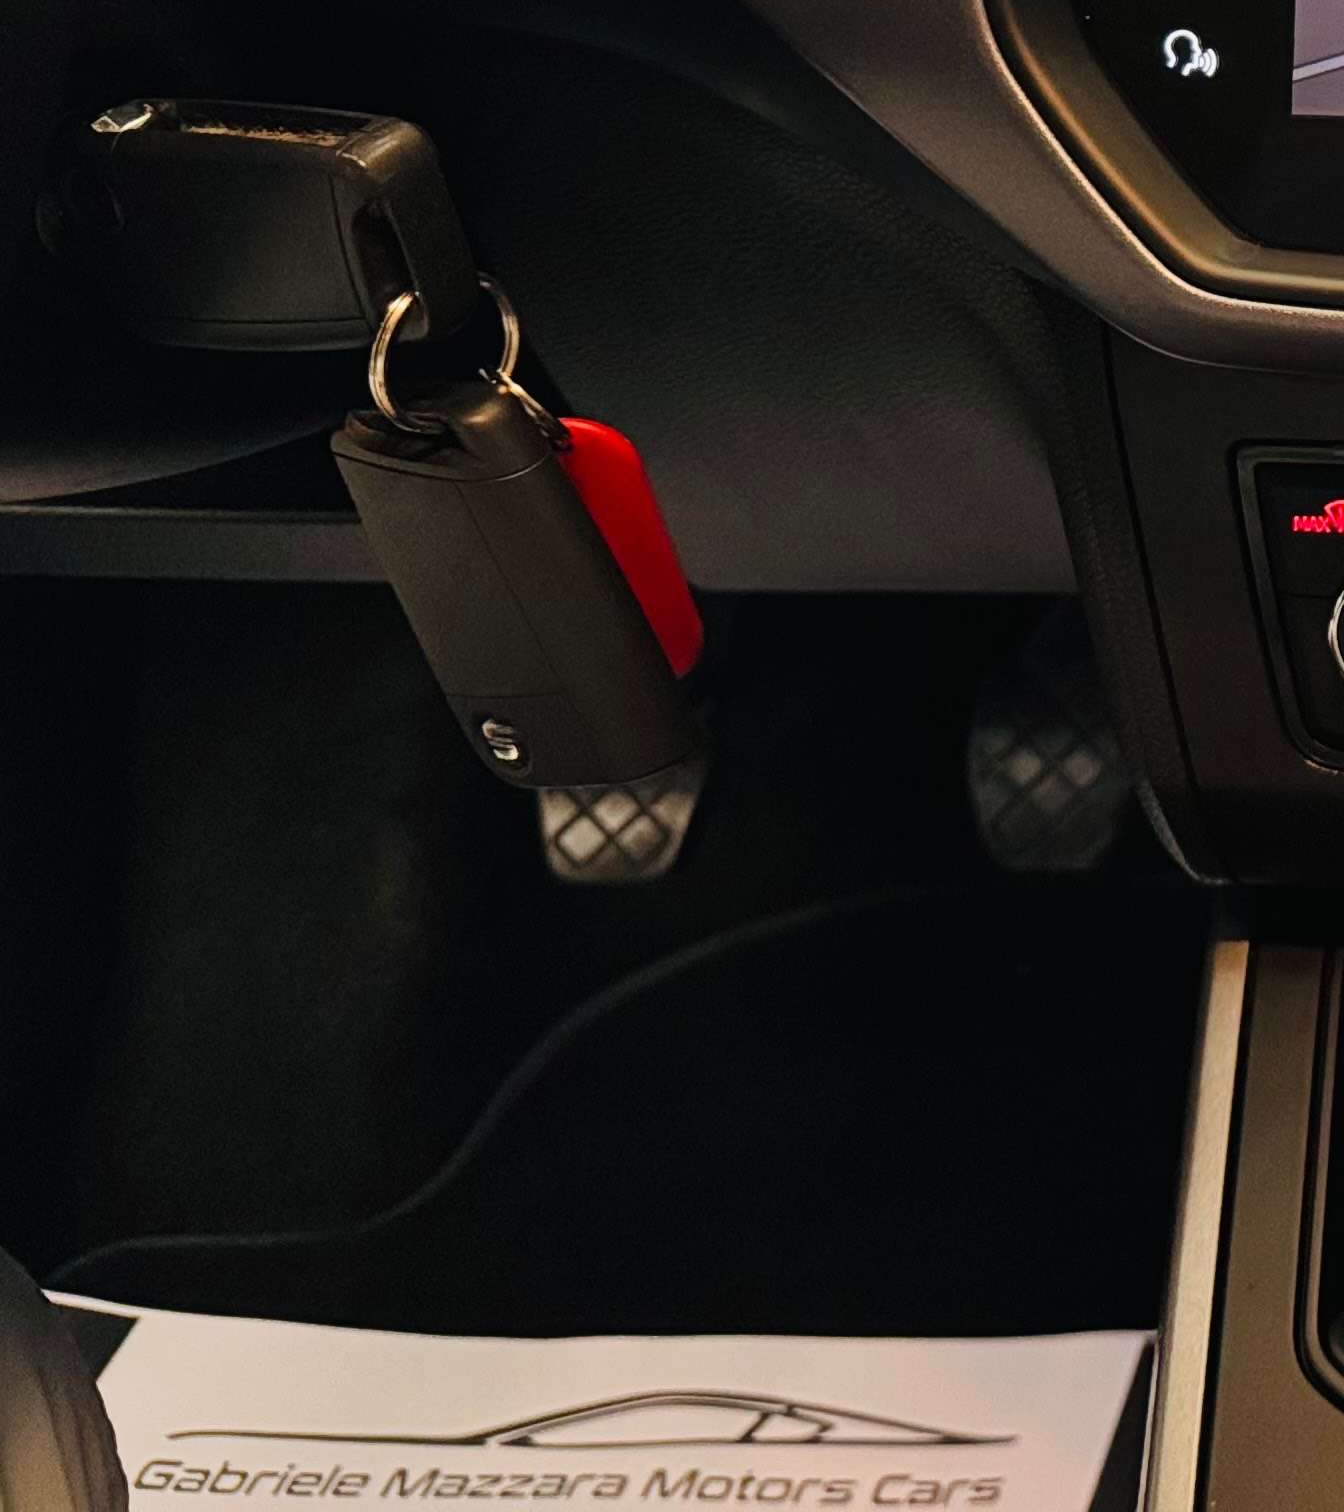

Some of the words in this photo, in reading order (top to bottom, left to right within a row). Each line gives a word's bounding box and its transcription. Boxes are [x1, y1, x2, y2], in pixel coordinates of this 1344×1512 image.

[1292, 515, 1332, 534] MAX
[133, 1458, 370, 1499] Gabriele
[380, 1465, 628, 1500] Mazzara
[640, 1467, 855, 1506] Motors
[871, 1471, 1006, 1507] Cars
